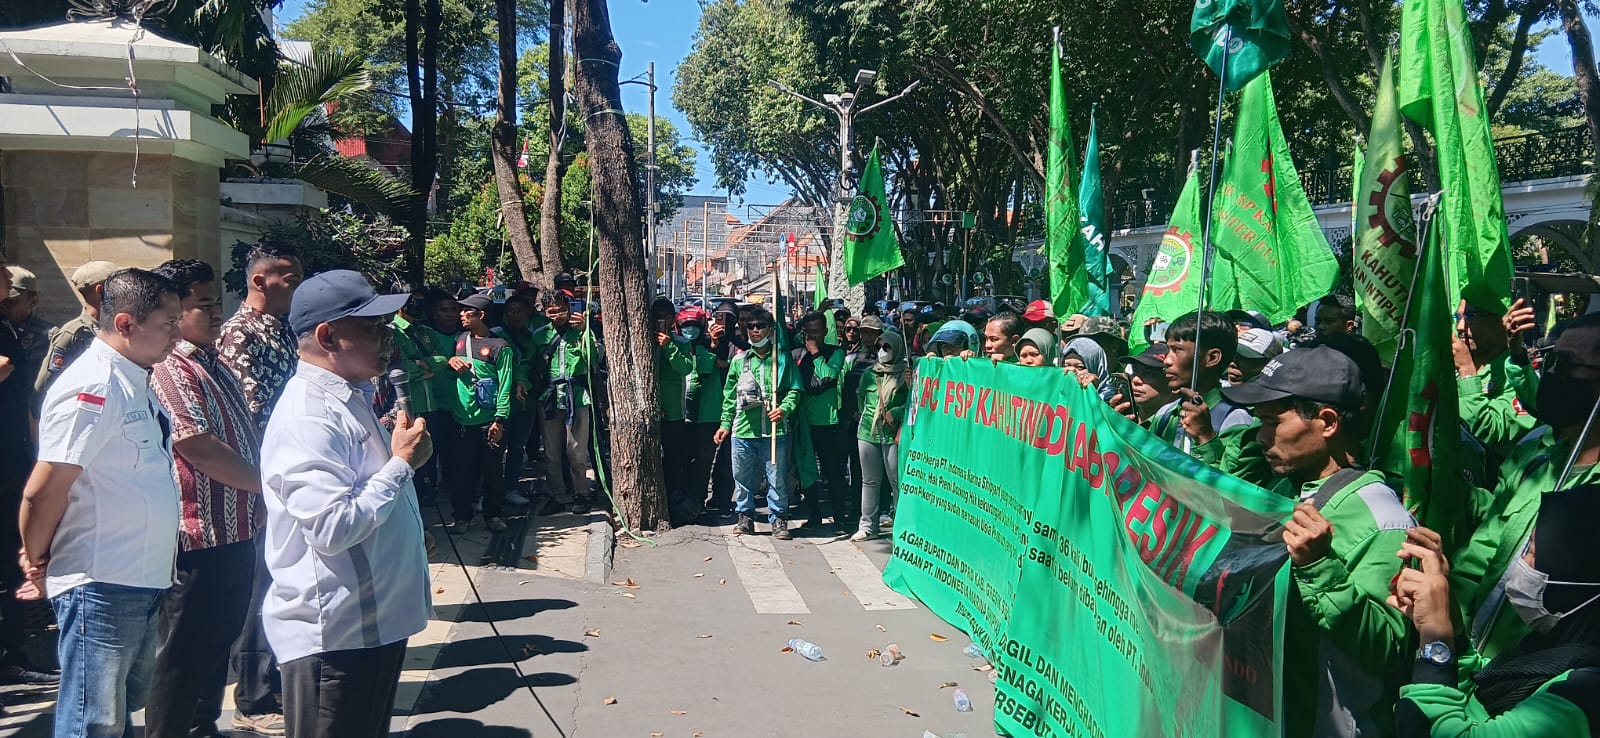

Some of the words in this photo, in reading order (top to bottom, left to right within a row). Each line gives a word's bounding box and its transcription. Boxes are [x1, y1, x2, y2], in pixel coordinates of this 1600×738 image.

[943, 380, 975, 420] FSP
[1059, 535, 1070, 557] 36
[899, 530, 923, 550] AGAR
[923, 541, 946, 563] BUPATI
[946, 554, 960, 570] DAN
[1035, 655, 1059, 689] DAN
[923, 560, 934, 576] PT.
[934, 567, 969, 601] INDONESIA
[1045, 694, 1076, 738] KERJA
[1107, 624, 1126, 656] oleh
[1126, 639, 1138, 671] PT.
